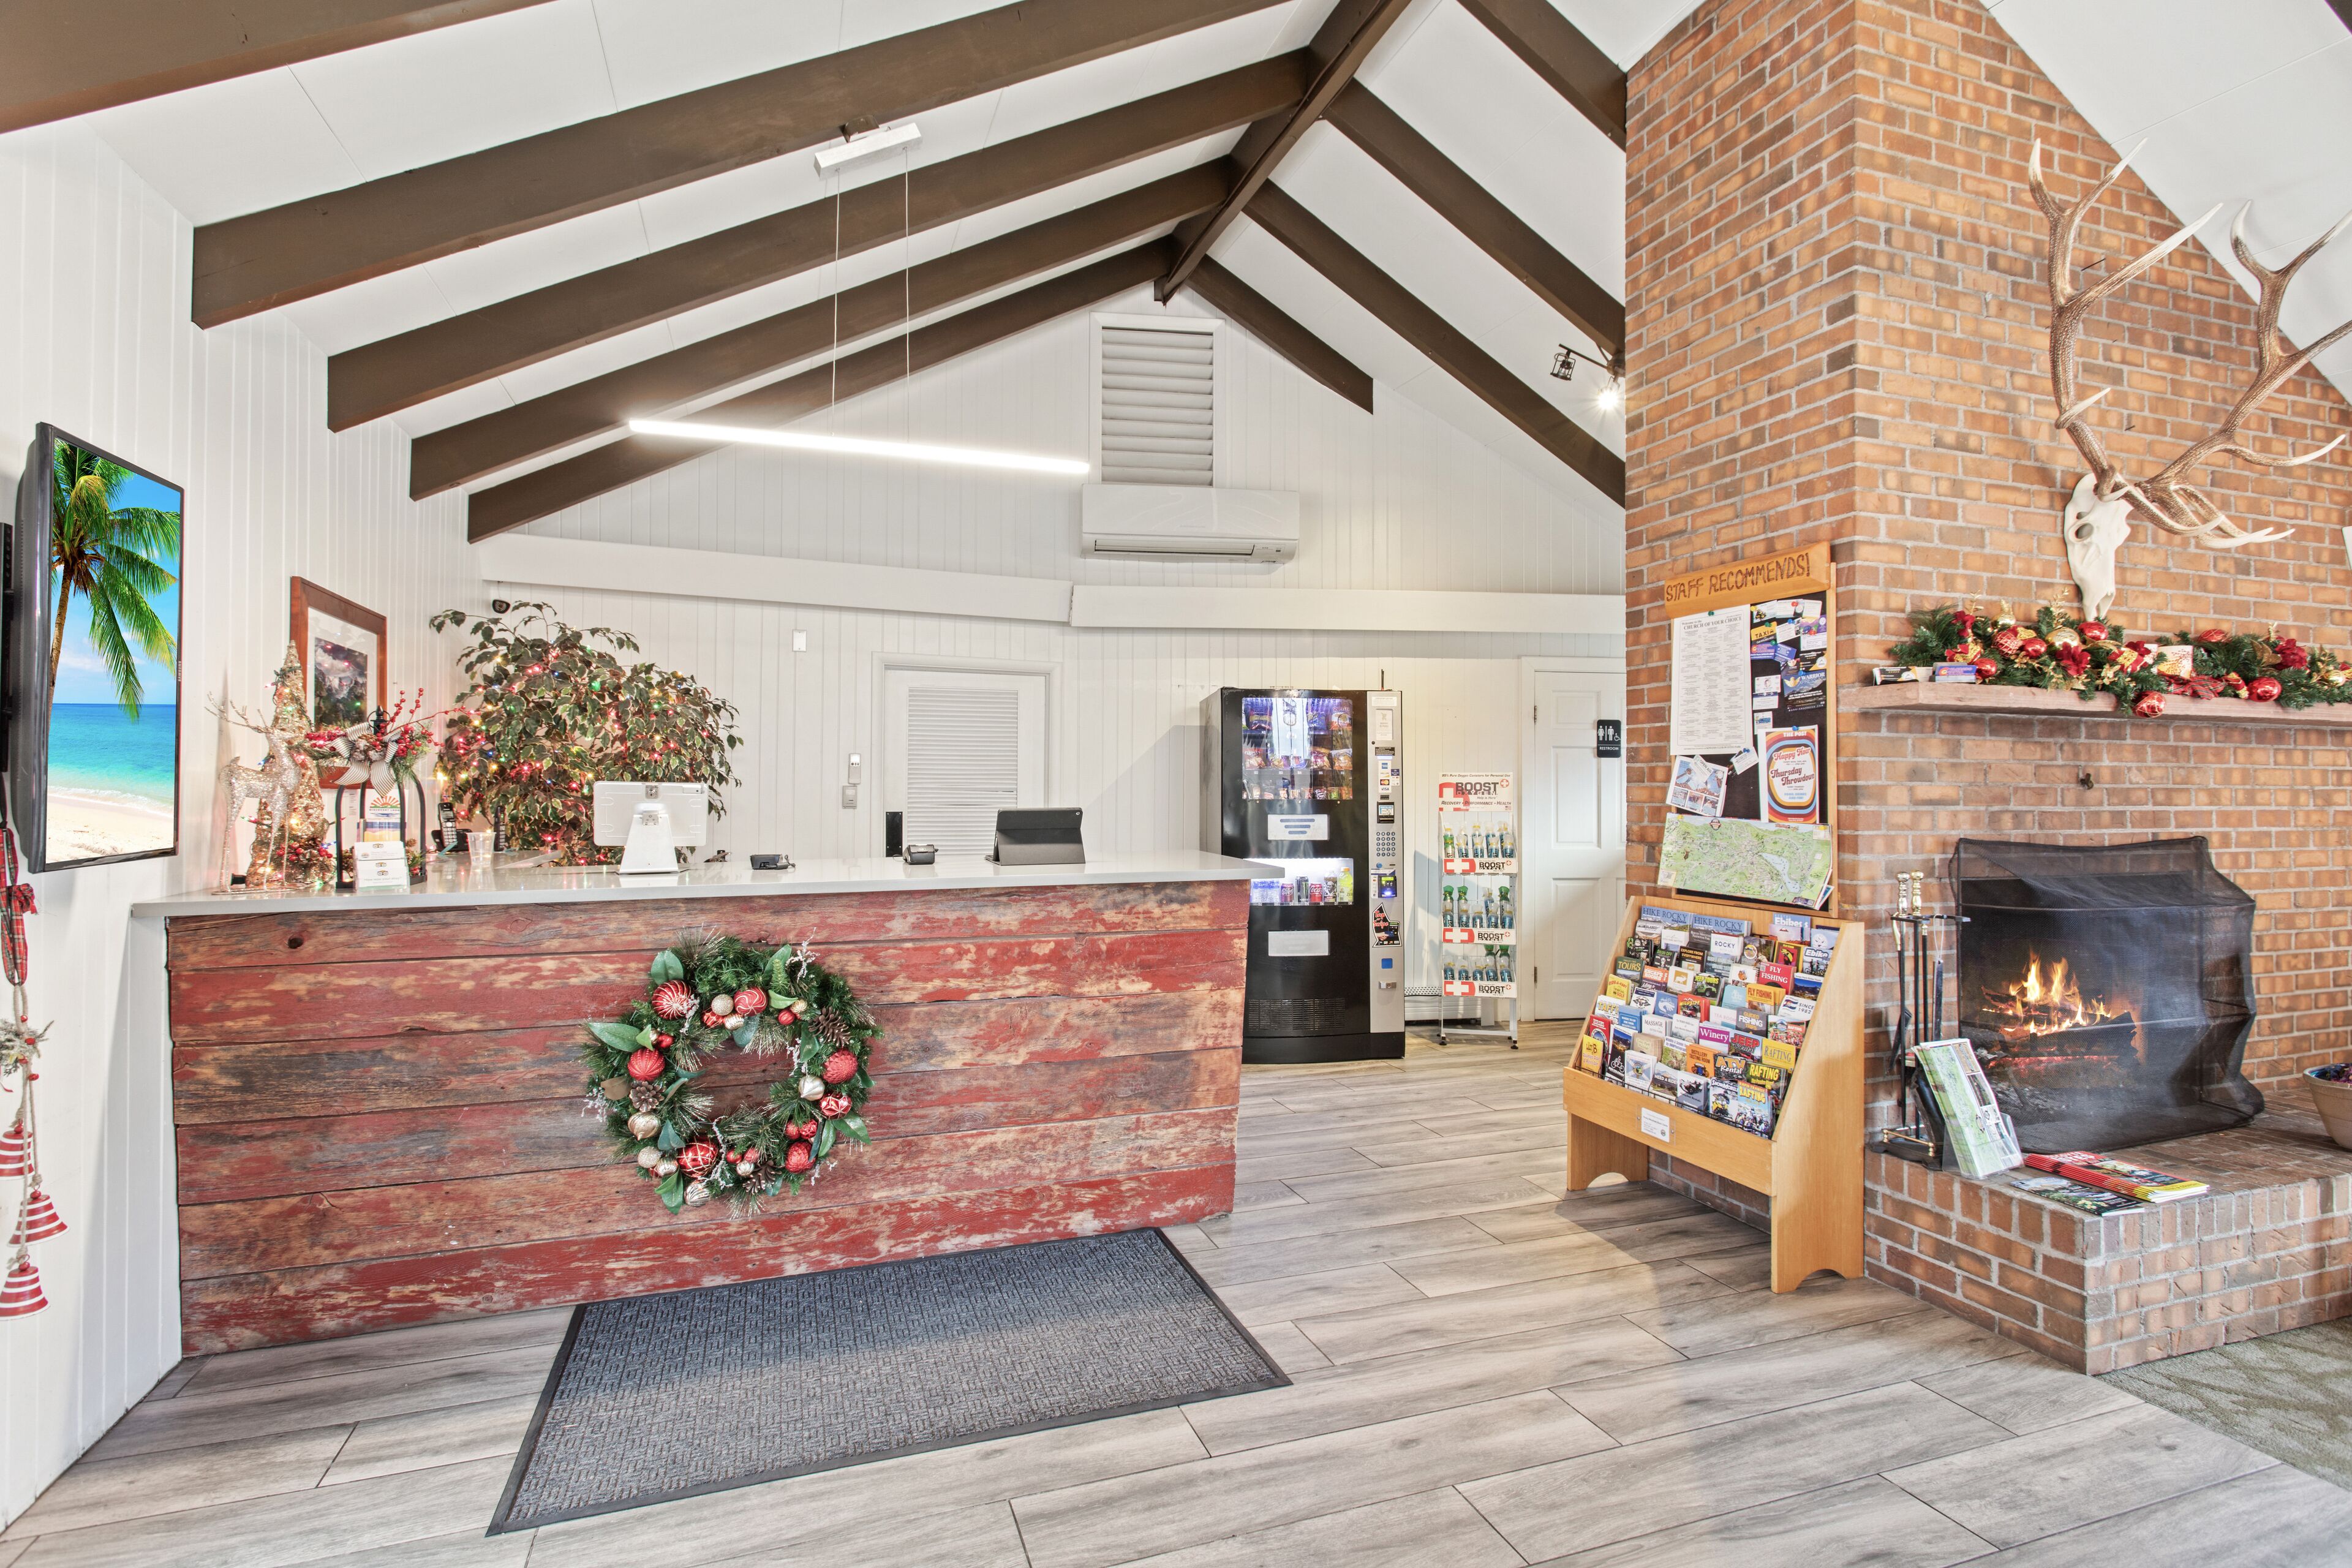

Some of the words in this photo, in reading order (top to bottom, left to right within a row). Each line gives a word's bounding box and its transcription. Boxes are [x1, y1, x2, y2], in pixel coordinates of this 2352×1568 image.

[1666, 578, 1703, 601] STAFF
[1708, 552, 1811, 595] RECOMMENDS!
[1755, 630, 1769, 638] TAXI
[1774, 752, 1796, 761] Happy
[1796, 747, 1810, 756] Hour
[1770, 767, 1802, 778] Thursday
[1781, 773, 1814, 786] Throwdown
[1455, 782, 1499, 791] BOOST
[1374, 910, 1385, 919] Tap
[1643, 908, 1660, 917] HIKE
[1662, 911, 1687, 921] ROCKY
[1373, 920, 1389, 929] Swipe
[1694, 916, 1713, 925] HIKE
[1715, 919, 1743, 930] ROCKY
[1774, 918, 1803, 927] Ebikes
[1806, 949, 1828, 959] Ebike
[1618, 961, 1641, 971] TOURS
[1762, 972, 1788, 984] FISHING
[1756, 989, 1772, 1000] FISHING
[1738, 1015, 1763, 1027] FISHING
[1700, 1028, 1729, 1043] Winery
[1731, 1034, 1760, 1048] JEEP
[1764, 1046, 1792, 1062] RAFTING
[1716, 1056, 1746, 1070] ATV
[1750, 1065, 1779, 1080] RAFTING
[1740, 1087, 1766, 1104] RAFTING
